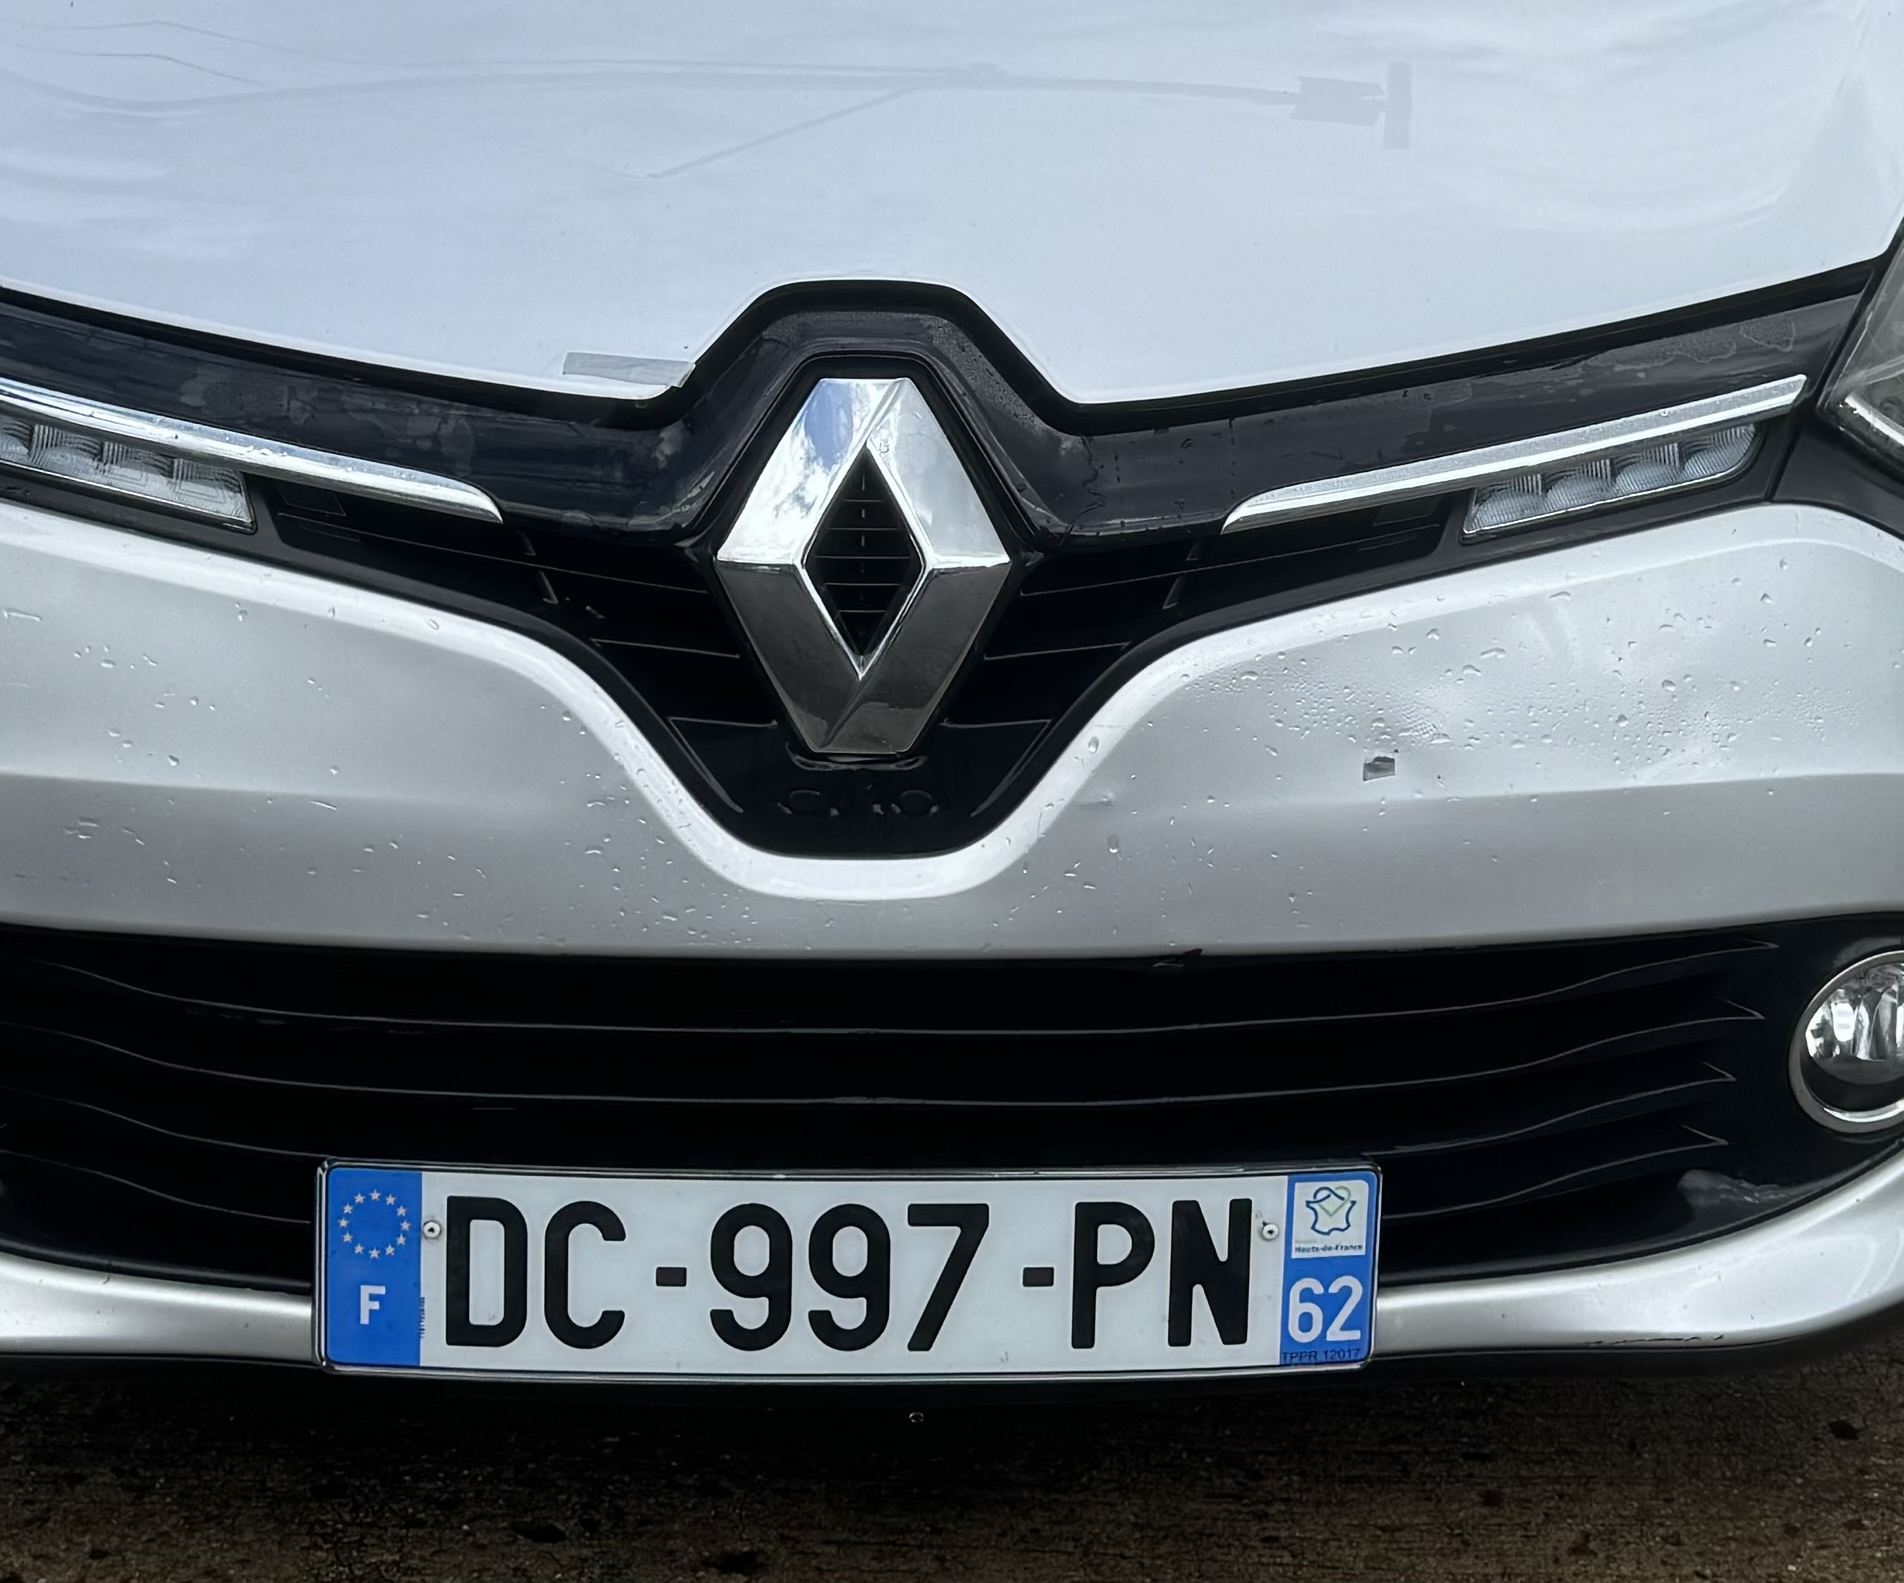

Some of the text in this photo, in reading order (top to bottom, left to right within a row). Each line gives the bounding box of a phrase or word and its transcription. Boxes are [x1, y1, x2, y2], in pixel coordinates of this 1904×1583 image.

[776, 789, 940, 818] CO
[445, 1195, 1254, 1352] DC-997-PN
[359, 1284, 387, 1325] F
[1288, 1275, 1364, 1344] 62
